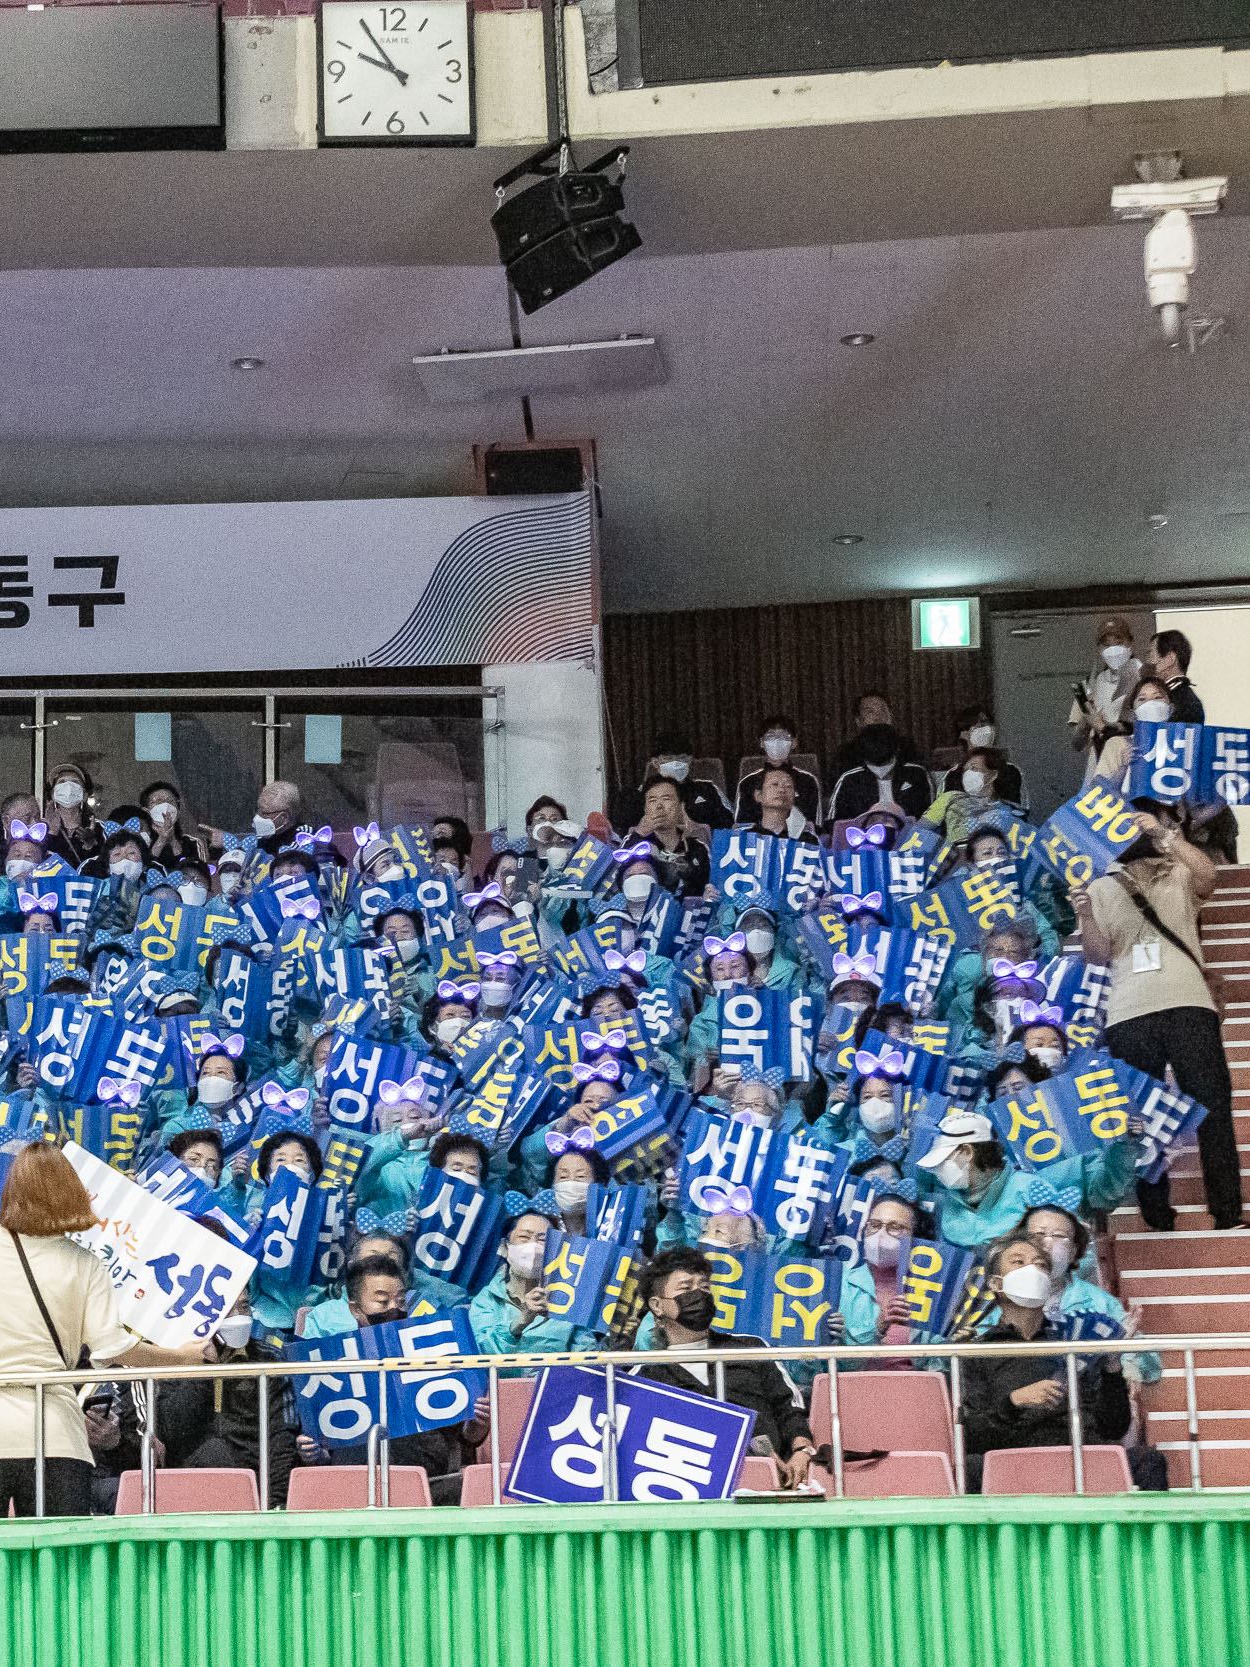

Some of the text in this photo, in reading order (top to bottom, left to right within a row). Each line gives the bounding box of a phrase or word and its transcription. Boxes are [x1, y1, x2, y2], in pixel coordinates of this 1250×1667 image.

[379, 8, 406, 31] 12
[327, 60, 346, 83] 9
[446, 60, 462, 83] 3
[386, 111, 405, 134] 6
[1143, 728, 1250, 803] 성동
[719, 836, 825, 911] 성동
[1040, 786, 1139, 886] 성동
[911, 870, 1016, 945] 성동
[437, 921, 541, 983] 성동
[222, 954, 296, 1036] 성동
[35, 1007, 165, 1088] 성동
[331, 1037, 447, 1123] 성동
[1007, 1067, 1130, 1163] 성동
[687, 1123, 837, 1234] 성동
[262, 1187, 348, 1279] 성동
[146, 1253, 232, 1337] 성동
[300, 1319, 469, 1440] 성동
[548, 1394, 718, 1500] 성동
